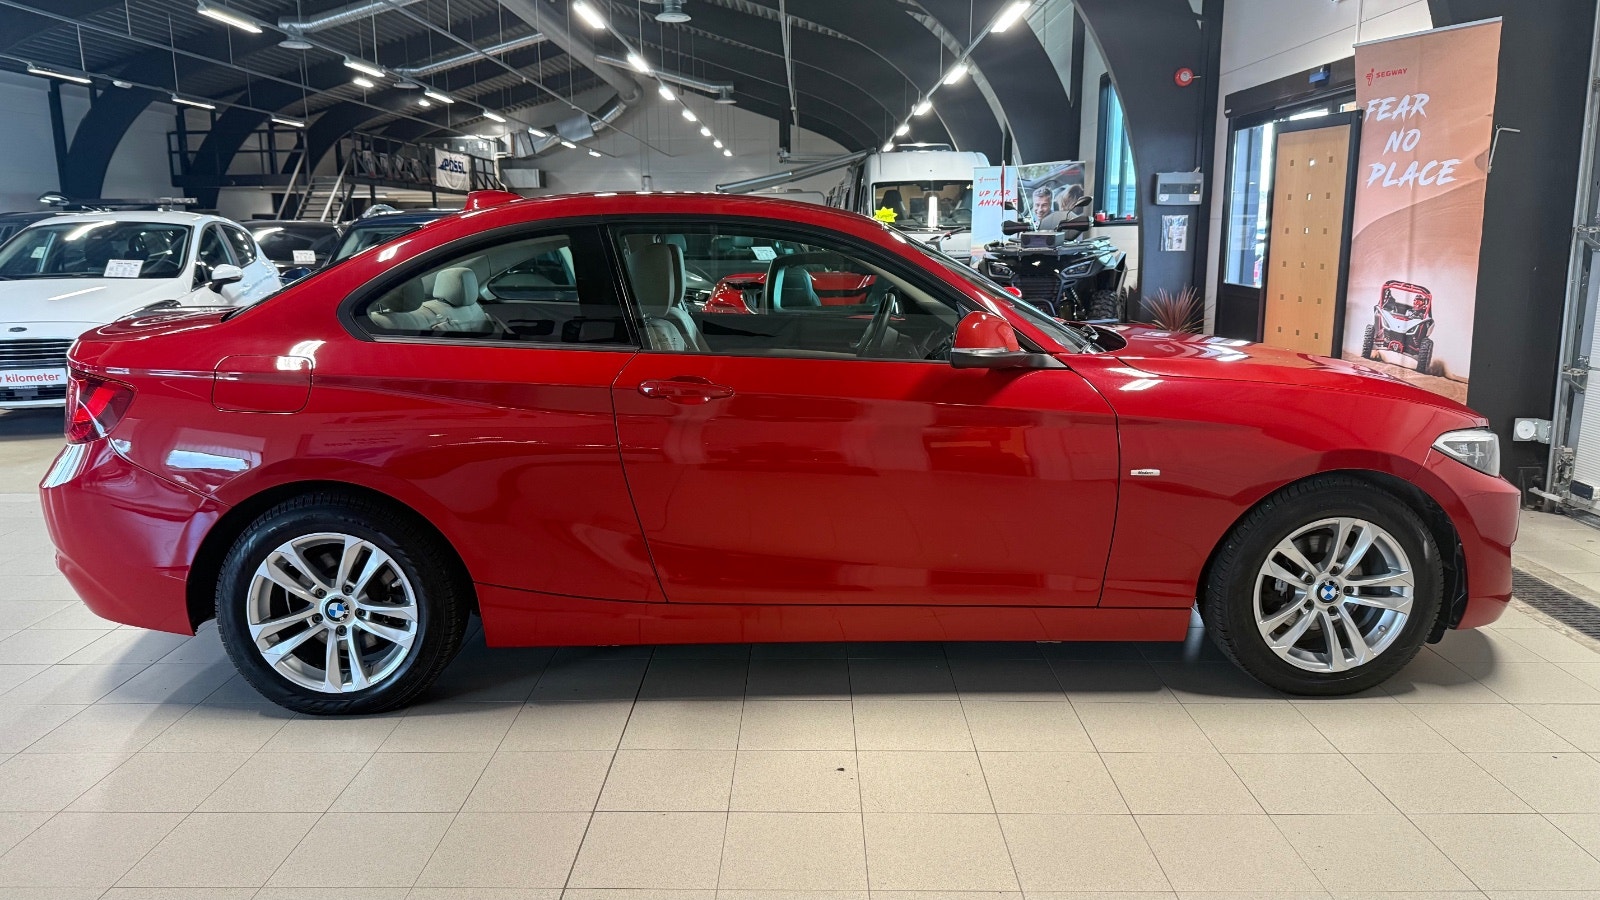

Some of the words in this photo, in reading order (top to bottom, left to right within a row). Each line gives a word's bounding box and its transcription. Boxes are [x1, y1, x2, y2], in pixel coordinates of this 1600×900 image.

[1376, 68, 1408, 79] SEGWAY
[1364, 93, 1430, 122] FEAR
[1383, 126, 1421, 156] NO
[1366, 159, 1462, 190] PLACE
[5, 373, 60, 383] kilometer
